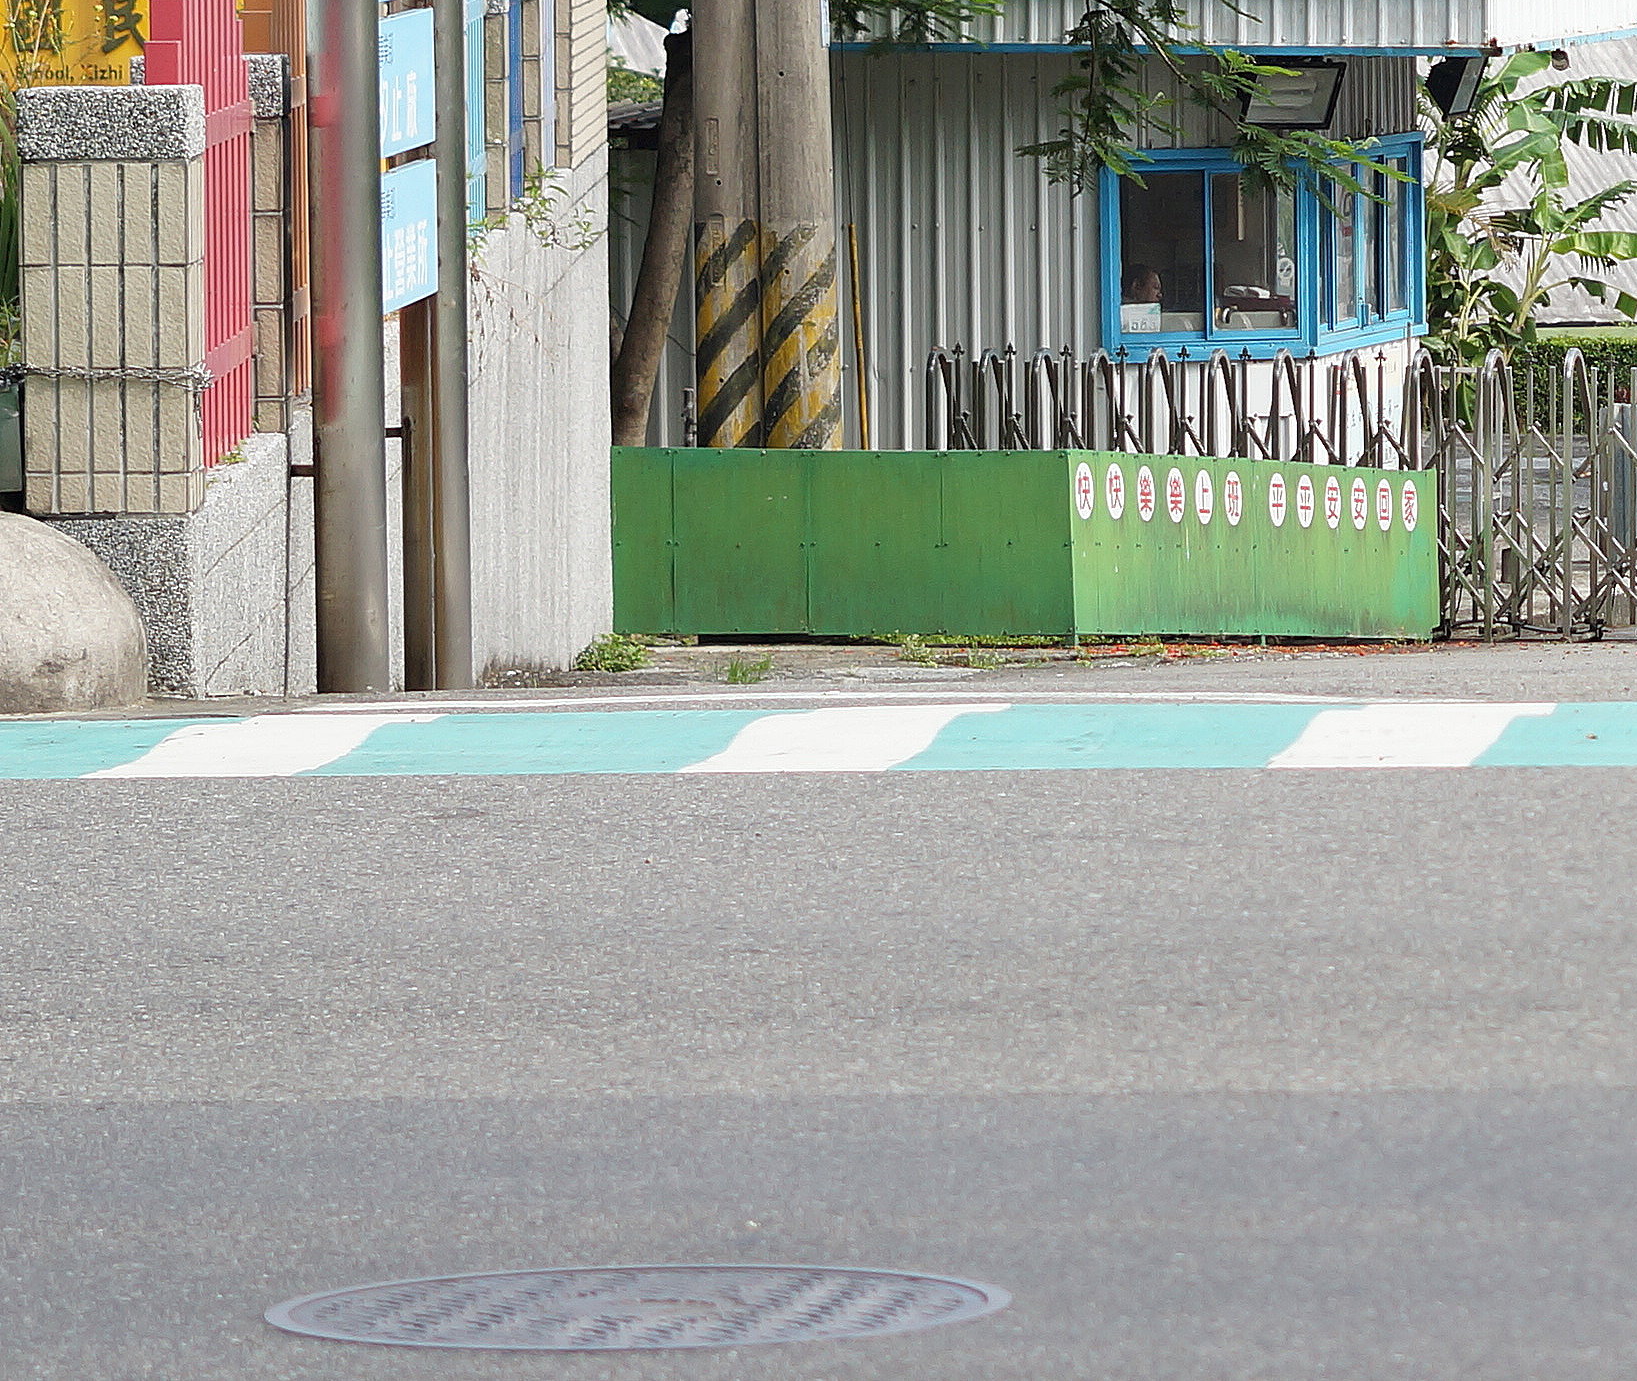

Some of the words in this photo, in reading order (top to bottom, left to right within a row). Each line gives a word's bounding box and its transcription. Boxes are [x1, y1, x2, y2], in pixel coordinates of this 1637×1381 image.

[1078, 471, 1243, 517] 快快樂樂上班
[1272, 482, 1416, 523] 平平安安回家
